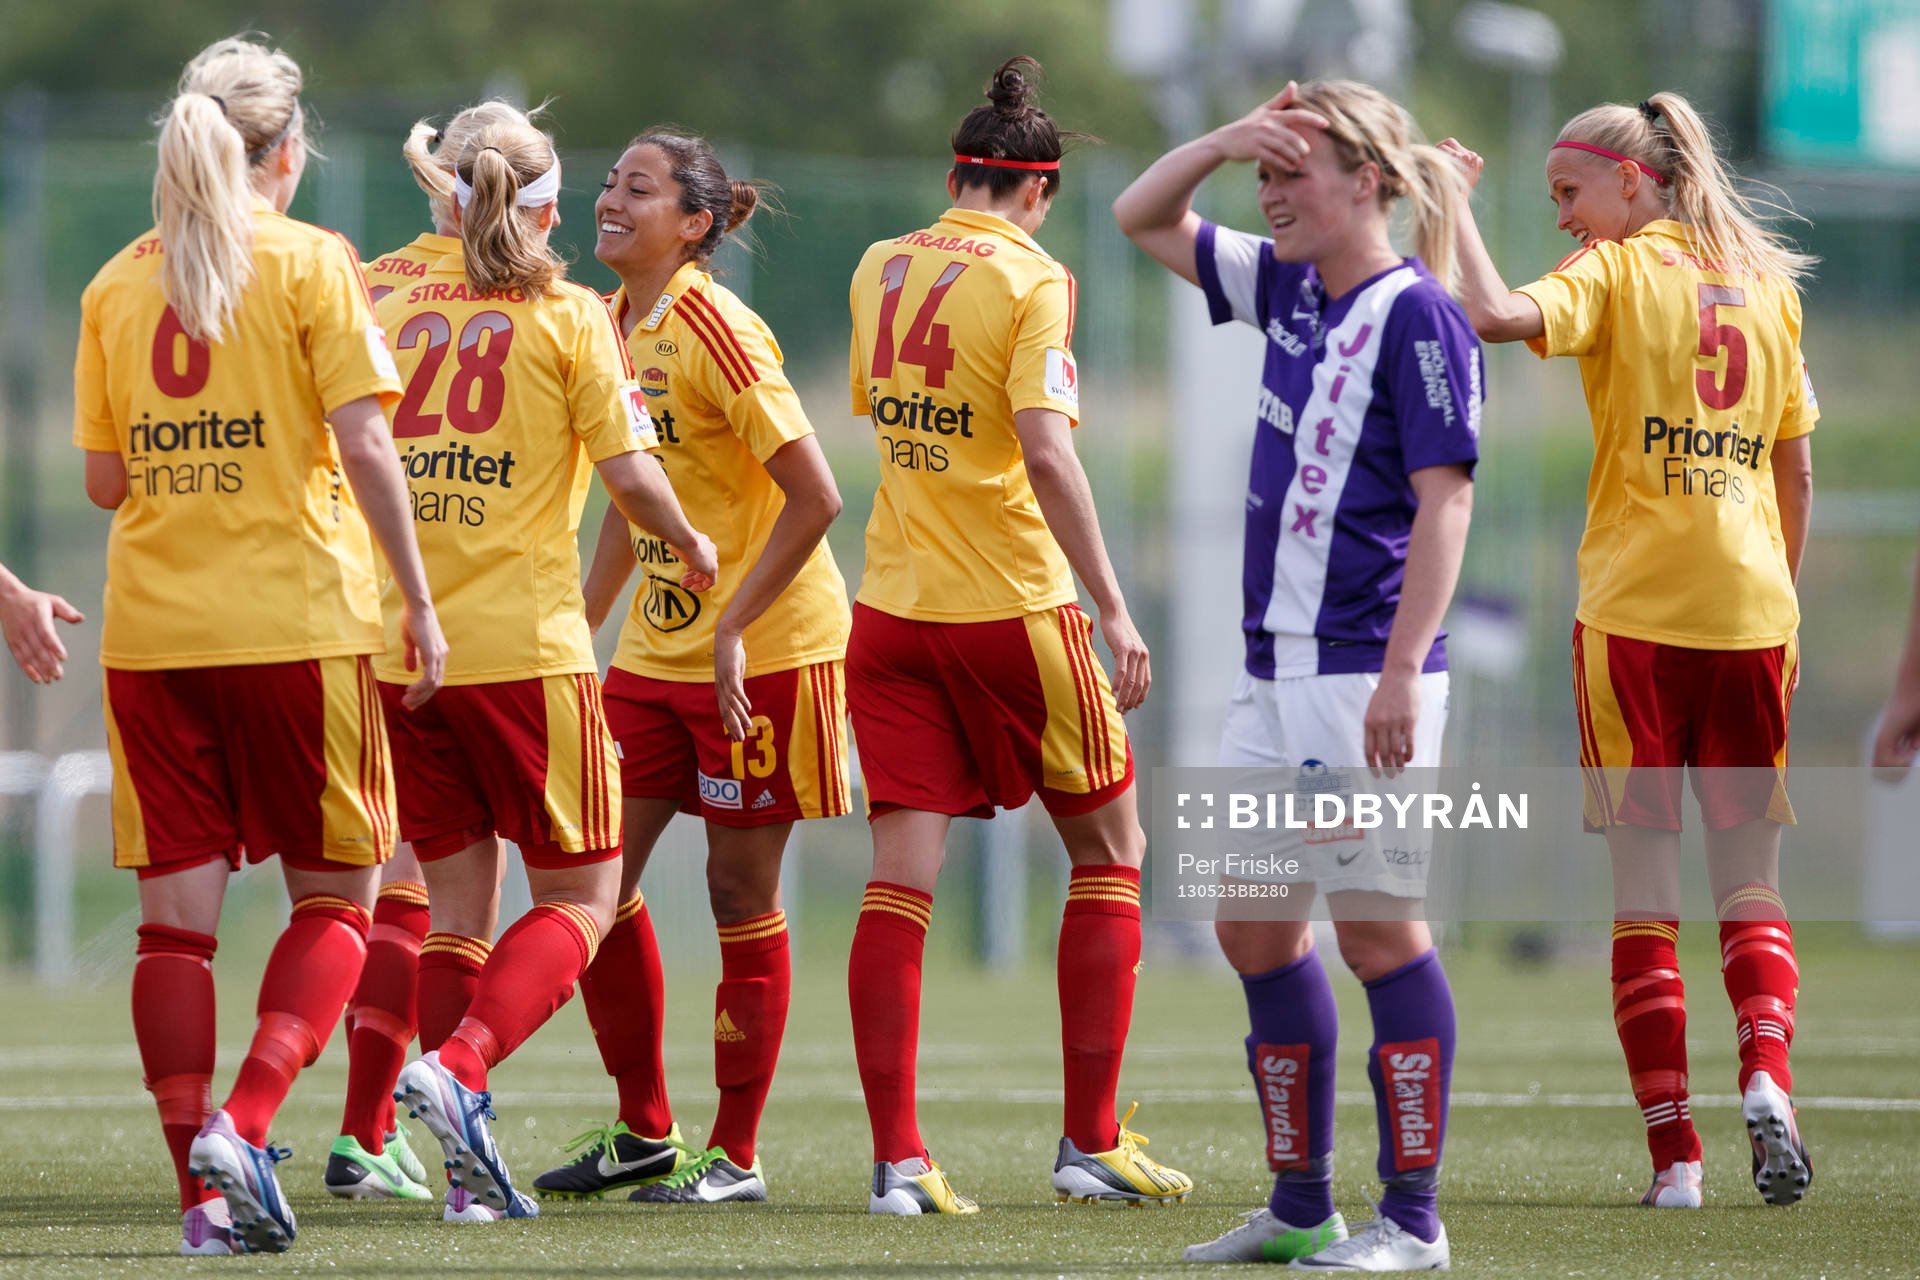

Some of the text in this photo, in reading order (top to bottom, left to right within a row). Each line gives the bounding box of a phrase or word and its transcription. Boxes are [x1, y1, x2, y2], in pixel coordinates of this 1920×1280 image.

[373, 257, 428, 278] STRA
[893, 231, 997, 258] STRABAG
[657, 342, 674, 354] KIA
[870, 253, 970, 390] 14
[1694, 282, 1749, 412] 5
[392, 310, 515, 439] 28
[129, 409, 266, 454] rioritet
[869, 385, 974, 439] ioritet
[1290, 321, 1374, 539] Jitex
[128, 455, 243, 499] Finans
[699, 775, 740, 802] BDO
[1262, 1055, 1300, 1161] Stavdal
[1389, 1052, 1433, 1157] Stavdal
